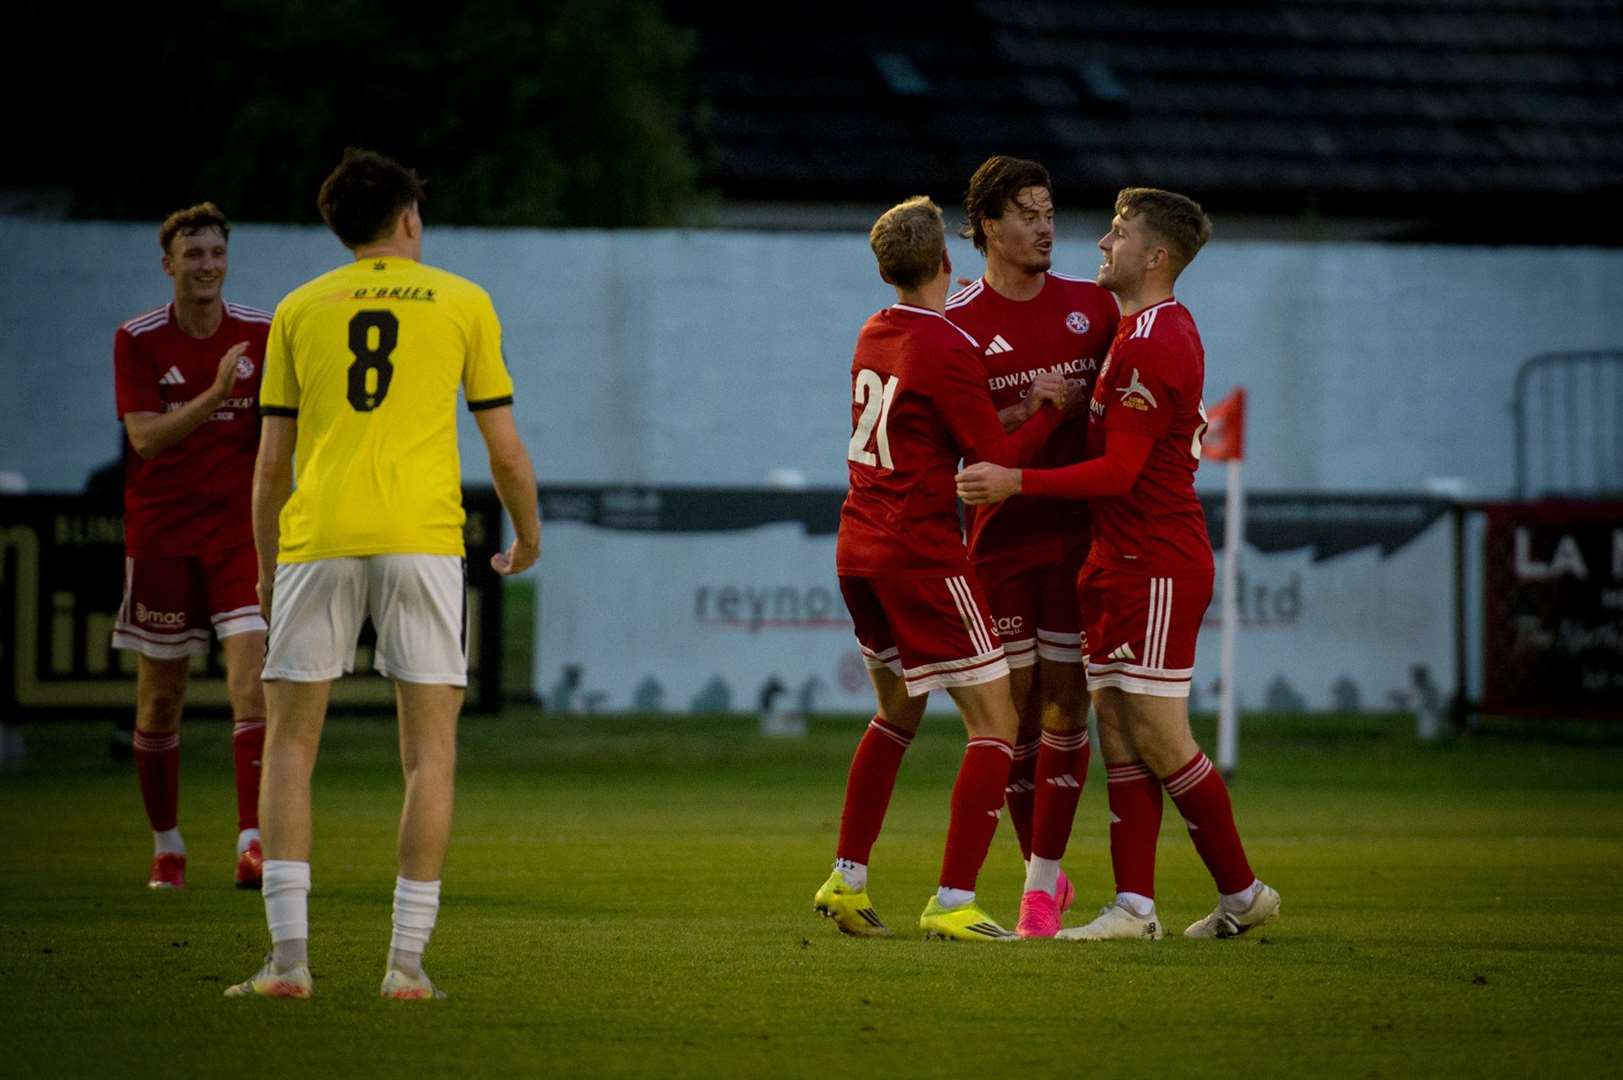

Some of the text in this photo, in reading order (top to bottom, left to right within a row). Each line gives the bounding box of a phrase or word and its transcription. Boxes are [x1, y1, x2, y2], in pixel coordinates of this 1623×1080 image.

[354, 286, 436, 299] O'BRIEN
[347, 309, 399, 412] 8
[1049, 357, 1098, 375] MACKA
[848, 369, 899, 470] 21
[1513, 526, 1589, 581] LA
[694, 585, 834, 633] reyno
